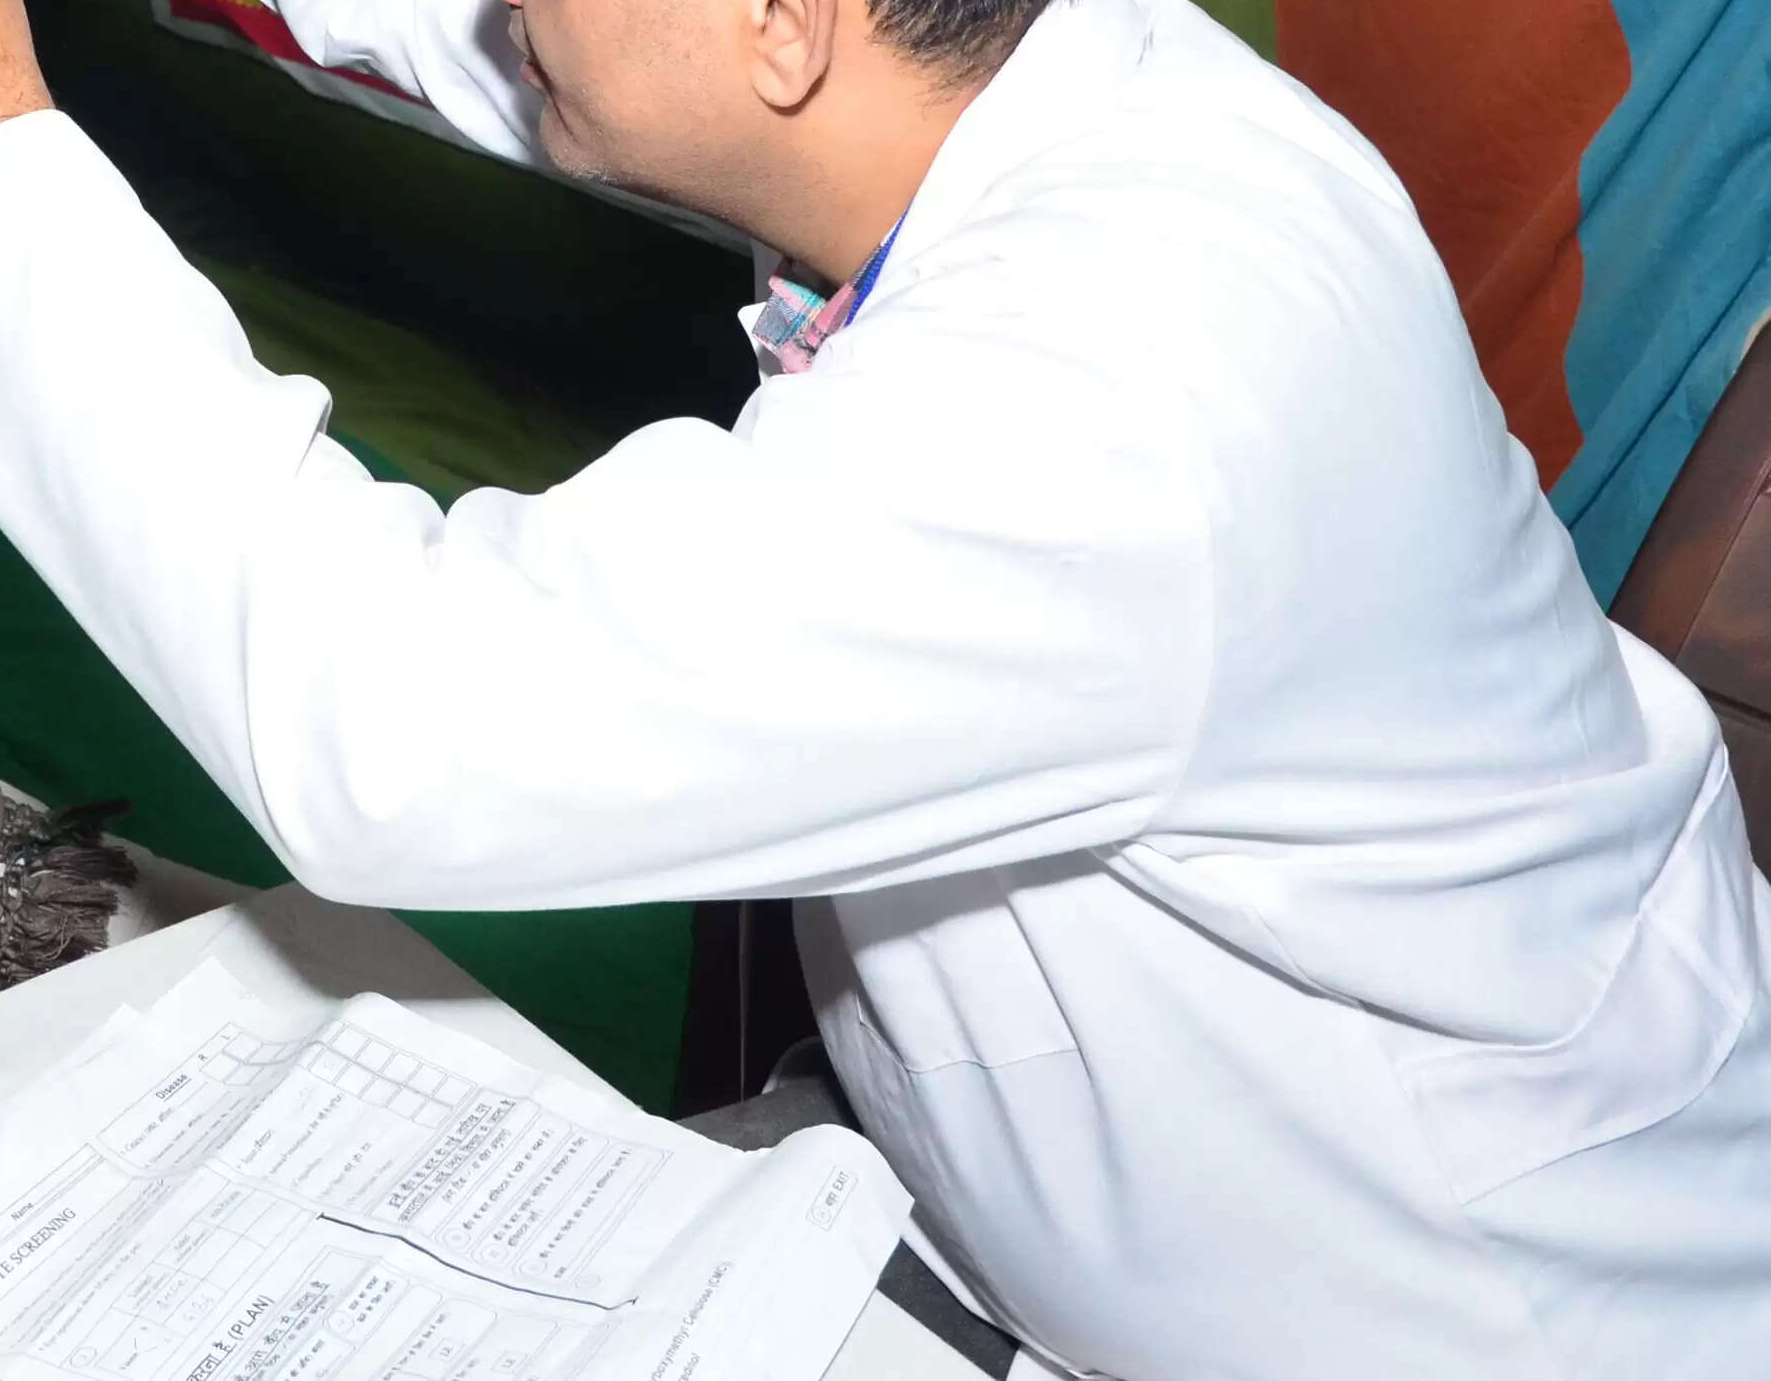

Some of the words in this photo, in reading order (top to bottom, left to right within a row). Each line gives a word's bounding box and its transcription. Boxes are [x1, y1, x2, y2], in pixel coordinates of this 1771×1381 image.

[155, 1073, 190, 1101] Disease
[11, 1203, 34, 1221] Name
[10, 1207, 76, 1267] SCREENING
[228, 1294, 274, 1340] (PLAN)
